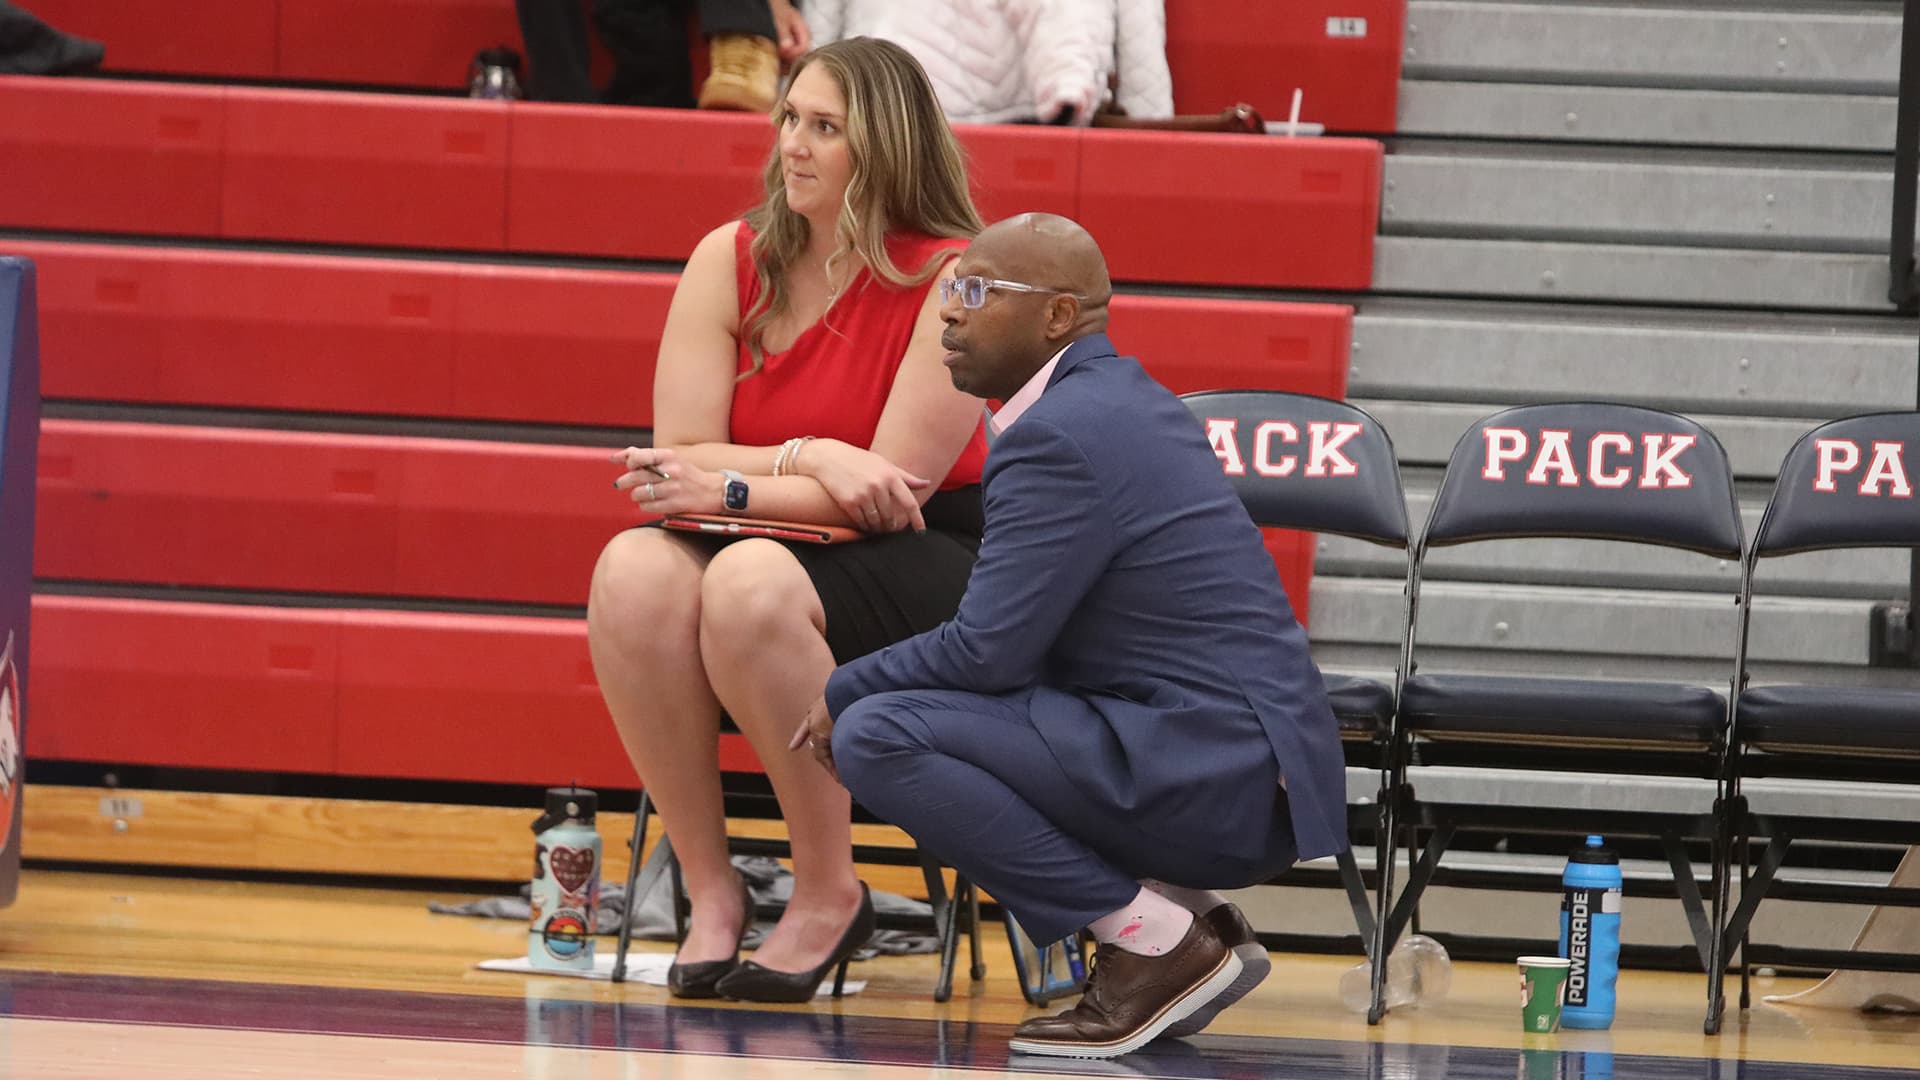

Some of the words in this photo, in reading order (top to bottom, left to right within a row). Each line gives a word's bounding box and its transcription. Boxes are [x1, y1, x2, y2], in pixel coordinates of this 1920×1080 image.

[1206, 418, 1363, 477] ACK
[1482, 427, 1697, 489] PACK
[1813, 439, 1914, 498] PA
[1569, 892, 1589, 1004] POWERADE
